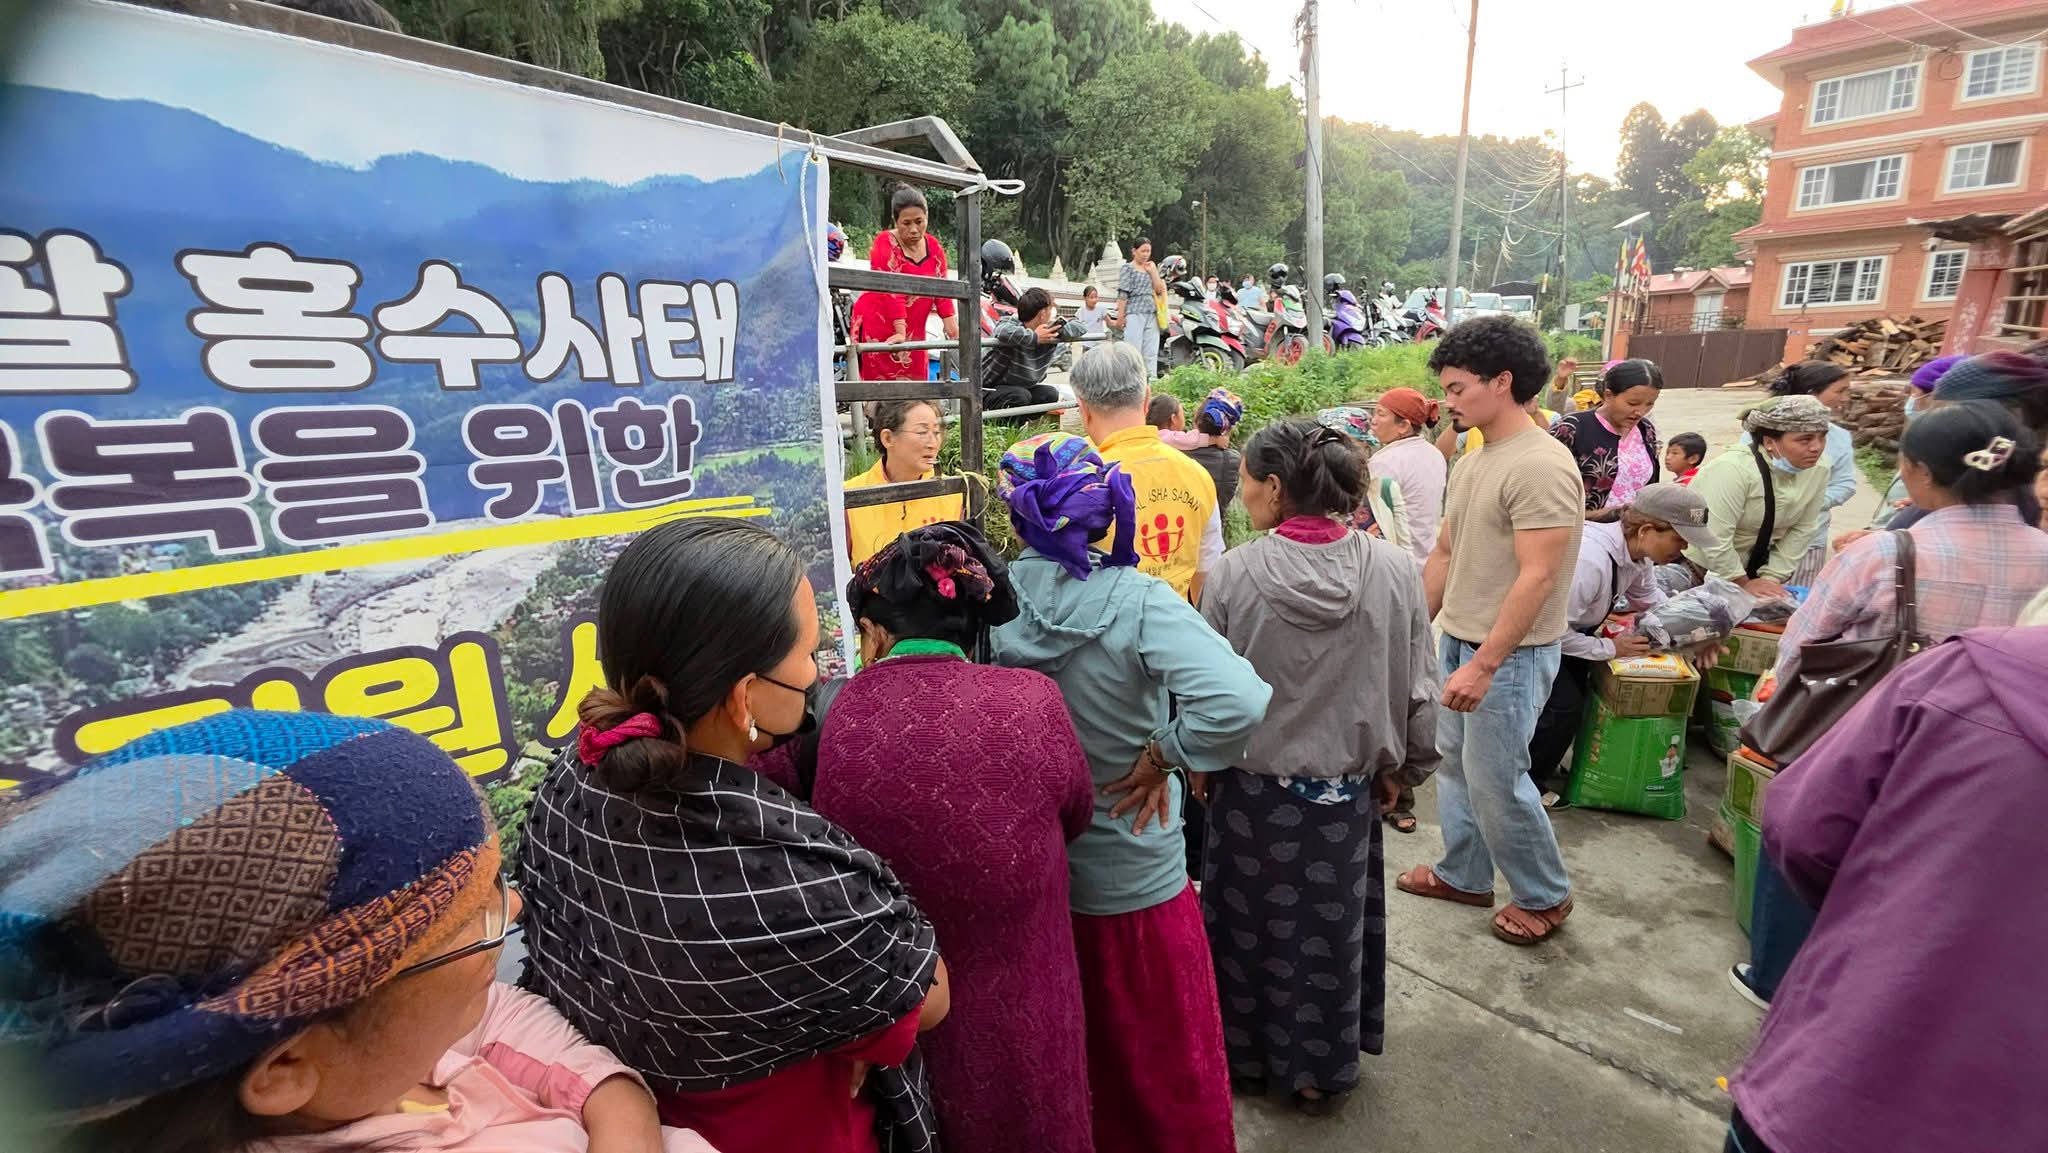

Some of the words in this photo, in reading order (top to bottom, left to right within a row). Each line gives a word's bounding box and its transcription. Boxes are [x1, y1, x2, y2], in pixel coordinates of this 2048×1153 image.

[174, 240, 740, 393] 홍수사태
[461, 394, 703, 523] 위한
[1172, 488, 1200, 512] SADAN
